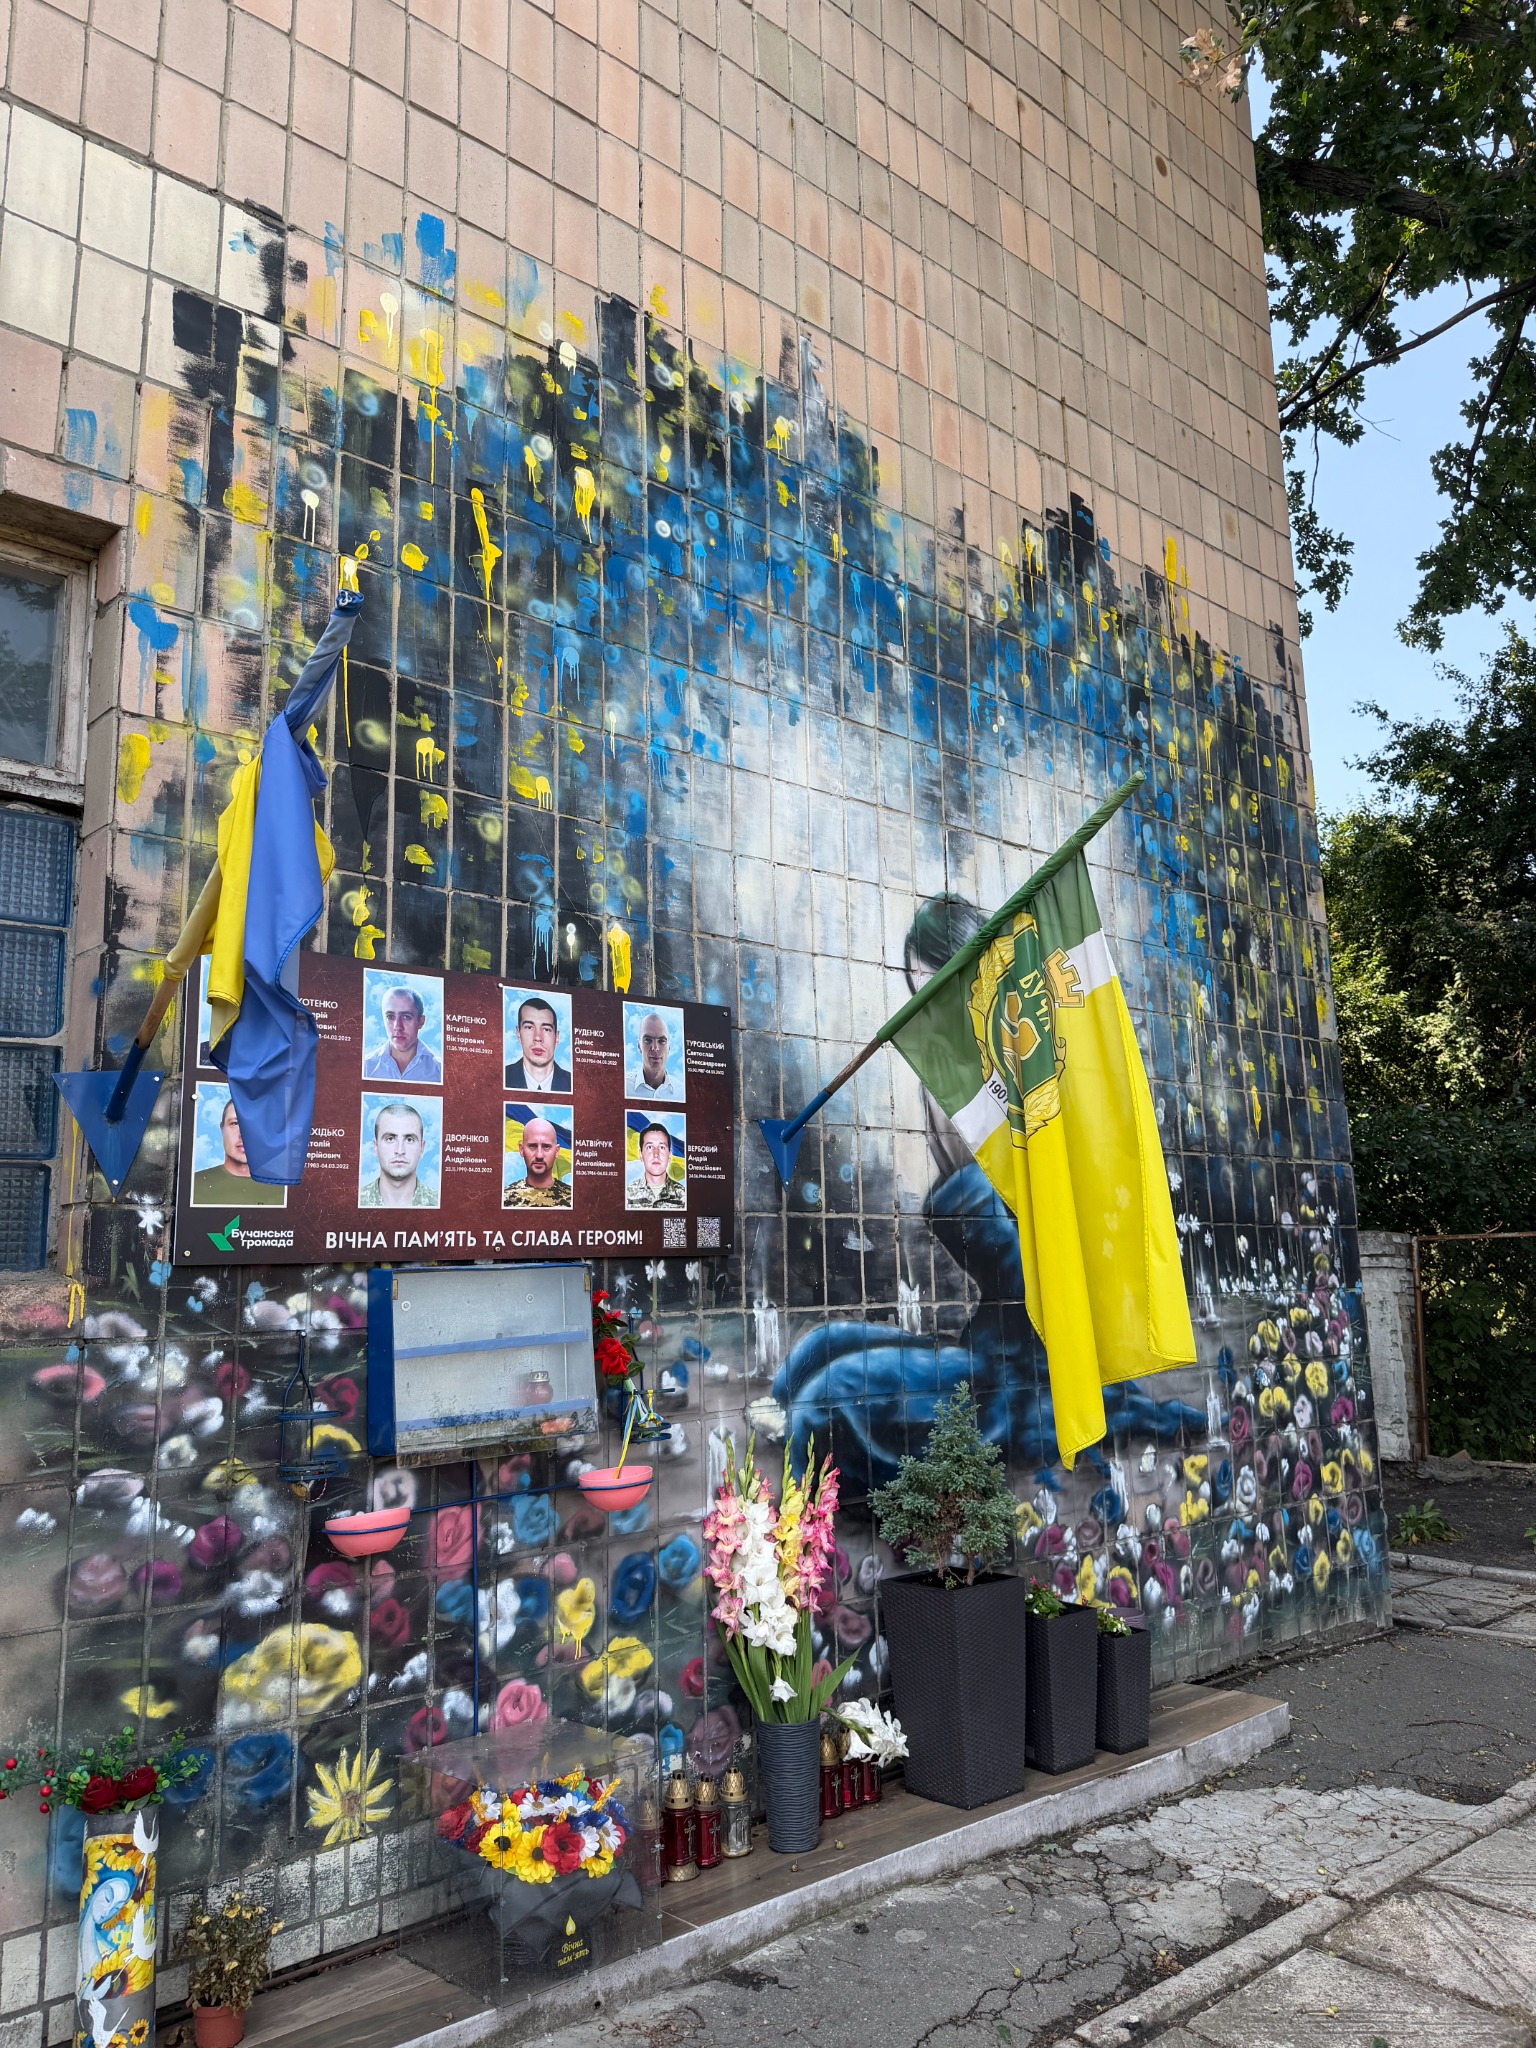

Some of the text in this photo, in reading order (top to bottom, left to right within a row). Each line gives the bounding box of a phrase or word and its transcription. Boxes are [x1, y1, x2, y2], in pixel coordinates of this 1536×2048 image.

[446, 1014, 487, 1025] КАРПЕНКО
[446, 1024, 470, 1033] Віталій
[574, 1027, 605, 1038] РУДЕНКО
[446, 1034, 485, 1045] Вікторович
[574, 1037, 594, 1046] Денис
[686, 1039, 725, 1050] ТУРОВСЬКИЙ
[574, 1046, 620, 1058] Олександрович
[309, 1127, 346, 1138] ХІДЬКО
[445, 1133, 490, 1143] ДВОРНІКОВ
[575, 1138, 613, 1148] МАТВІЙЧУК
[445, 1144, 471, 1154] Андрій
[575, 1149, 598, 1158] Андрій
[687, 1144, 718, 1153] ВЕРБОВИЙ
[306, 1151, 341, 1160] ерійович
[445, 1155, 487, 1165] Андрійович
[688, 1154, 708, 1163] Андрій
[575, 1159, 616, 1167] Анатолійович
[687, 1163, 722, 1171] Олексійович
[231, 1229, 294, 1241] Бучанська
[325, 1229, 643, 1249] ВІЧНА ПАМ’ЯТЬ ТА СЛАВА ГЕРОЯМ!
[241, 1239, 294, 1250] громада
[561, 1939, 584, 1954] Вічна
